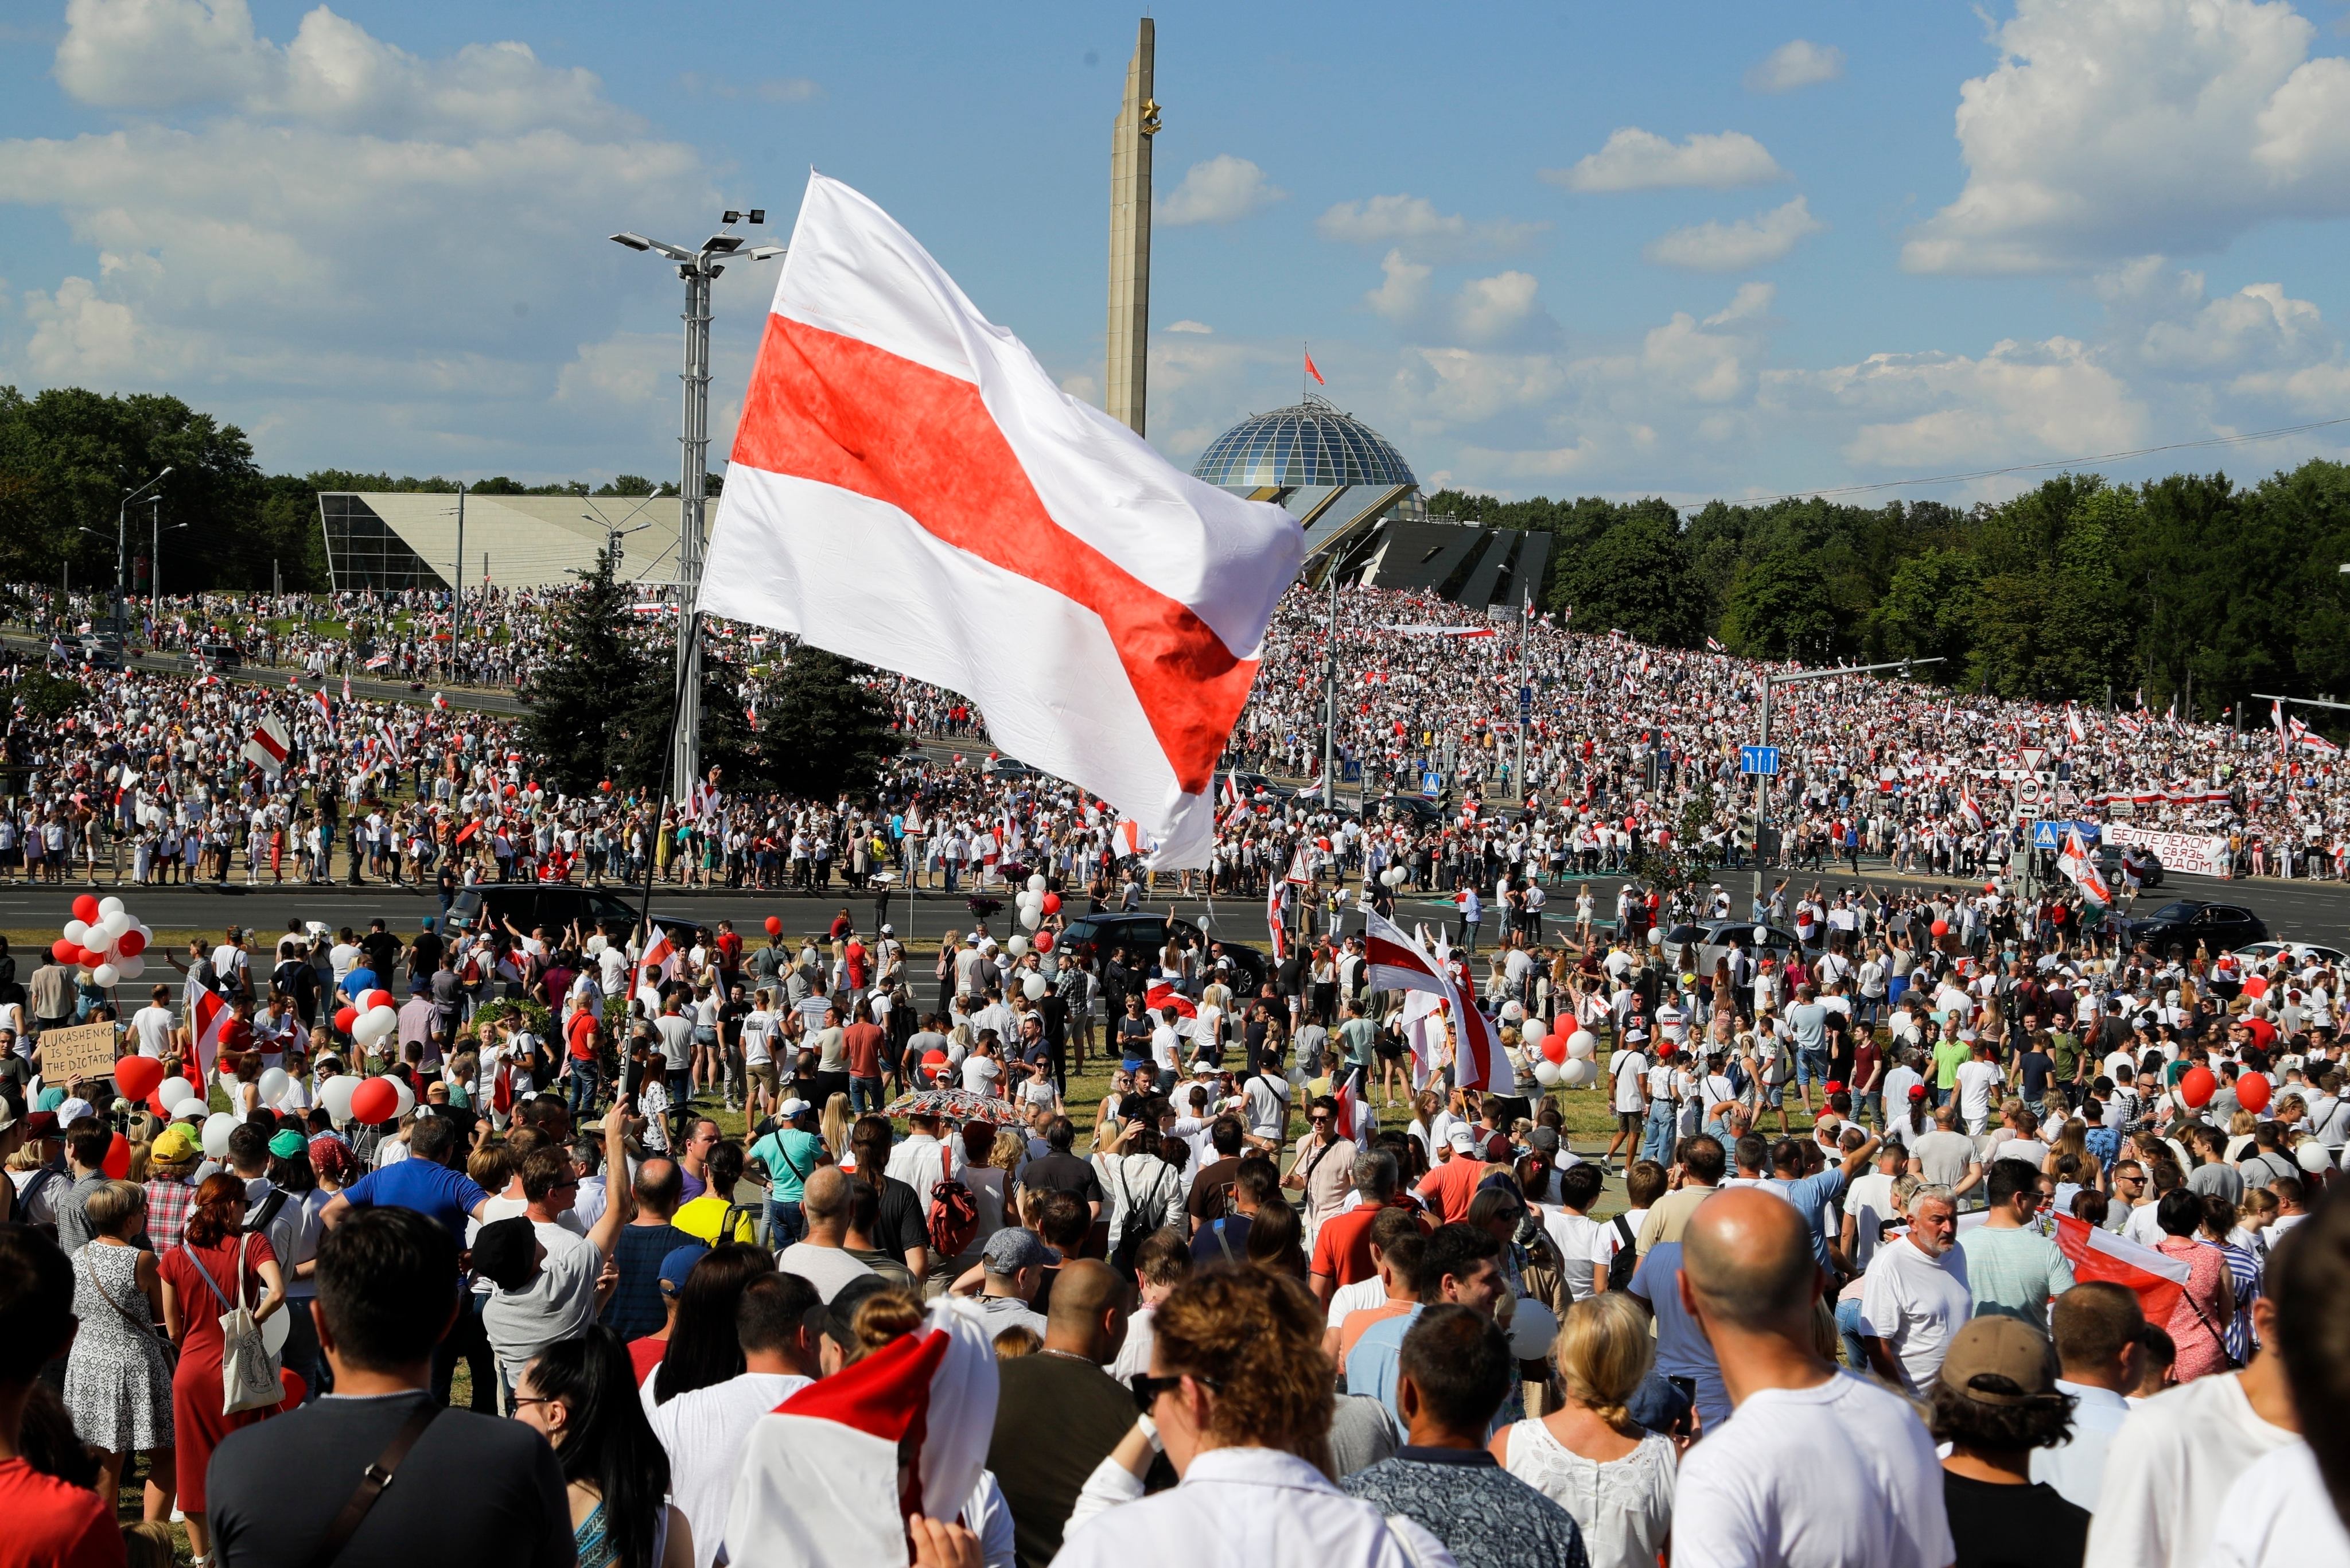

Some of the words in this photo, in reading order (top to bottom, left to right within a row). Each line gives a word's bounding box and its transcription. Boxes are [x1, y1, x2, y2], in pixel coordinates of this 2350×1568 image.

[2111, 828, 2212, 850] БЕЛТЕЛЕКОМ
[2162, 847, 2204, 859] СВЯЗЬ
[44, 1027, 114, 1047] LUKASHENKO
[619, 1010, 633, 1076] BLASTER
[50, 1048, 61, 1058] IS
[66, 1042, 101, 1056] STILL
[46, 1061, 65, 1075] THE
[69, 1053, 115, 1071] DICTATOR
